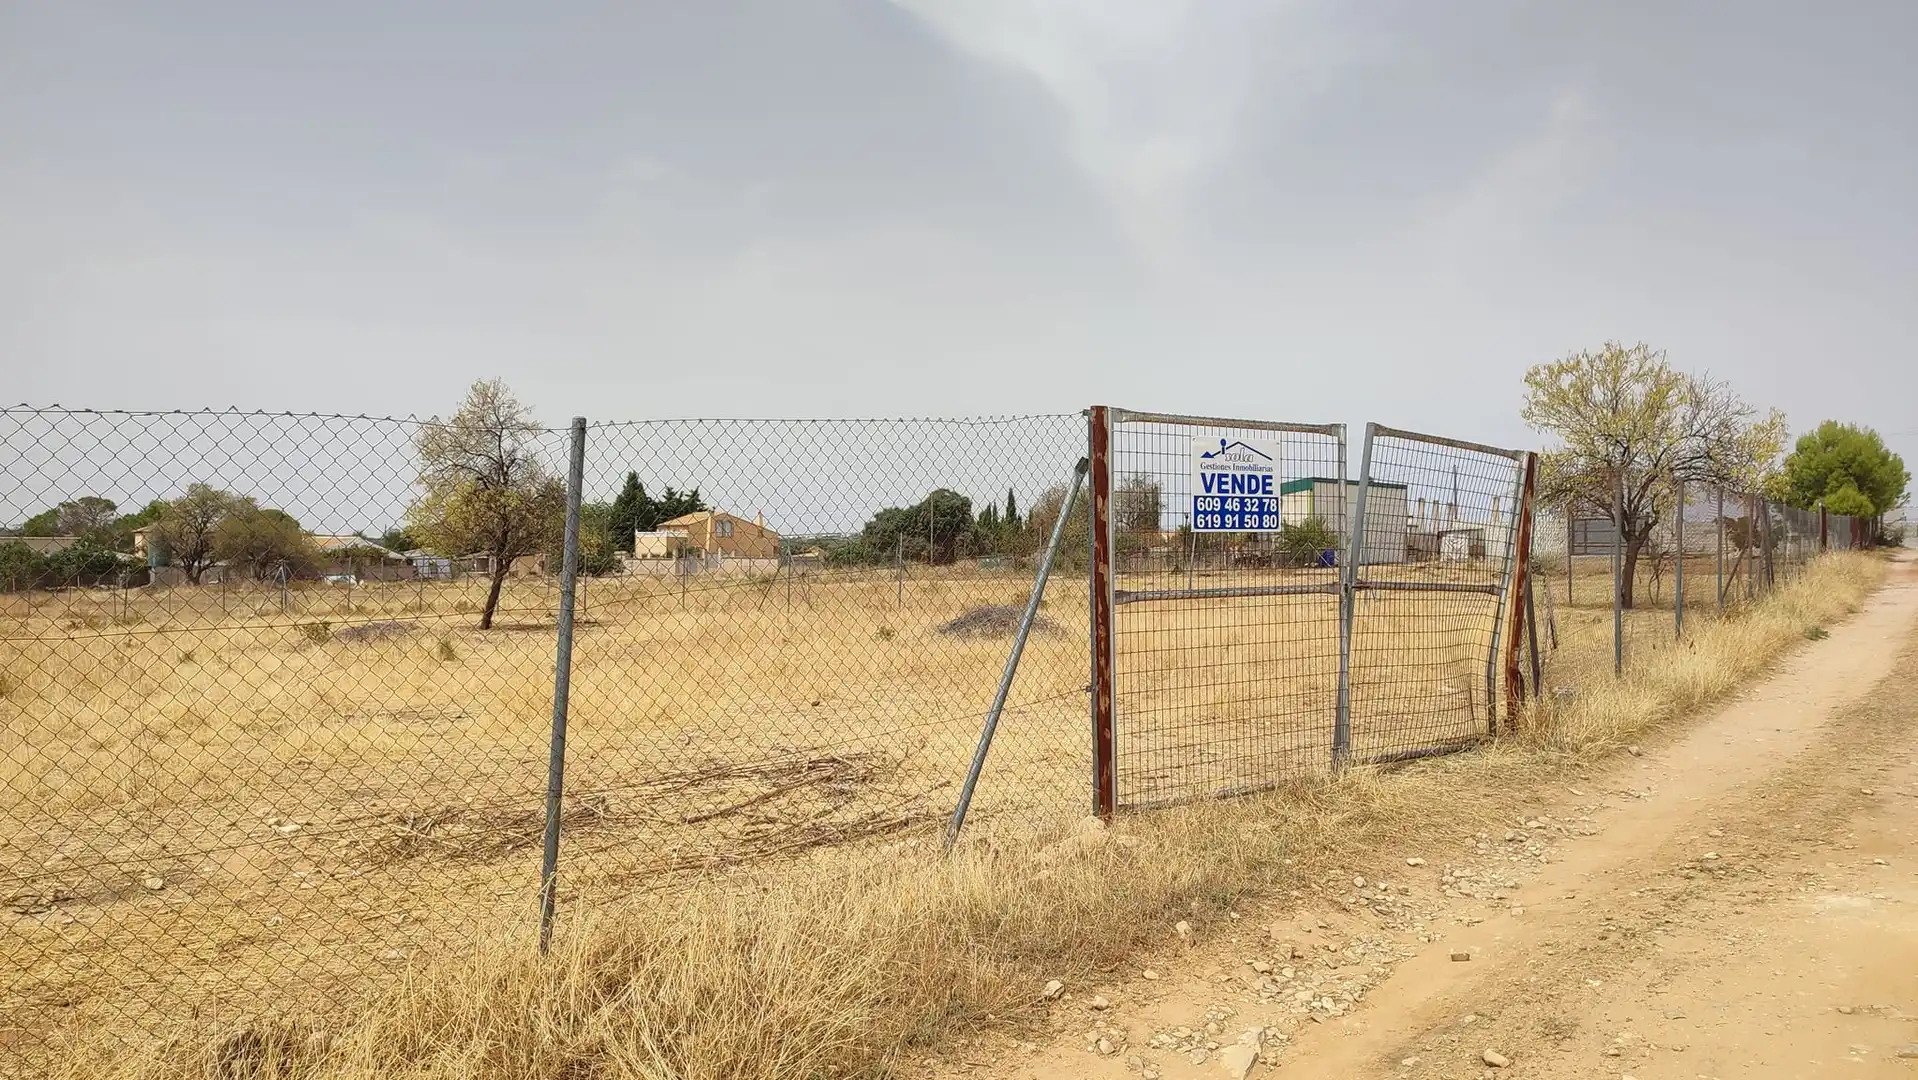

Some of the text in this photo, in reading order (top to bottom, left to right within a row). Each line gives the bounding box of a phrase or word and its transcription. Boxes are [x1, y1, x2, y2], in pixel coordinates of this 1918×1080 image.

[1200, 461, 1273, 473] Gestiones Inmobiliarias
[1200, 472, 1273, 495] VENDE
[1197, 497, 1277, 512] 609 46 32 78
[1197, 514, 1277, 528] 619 91 50 80
